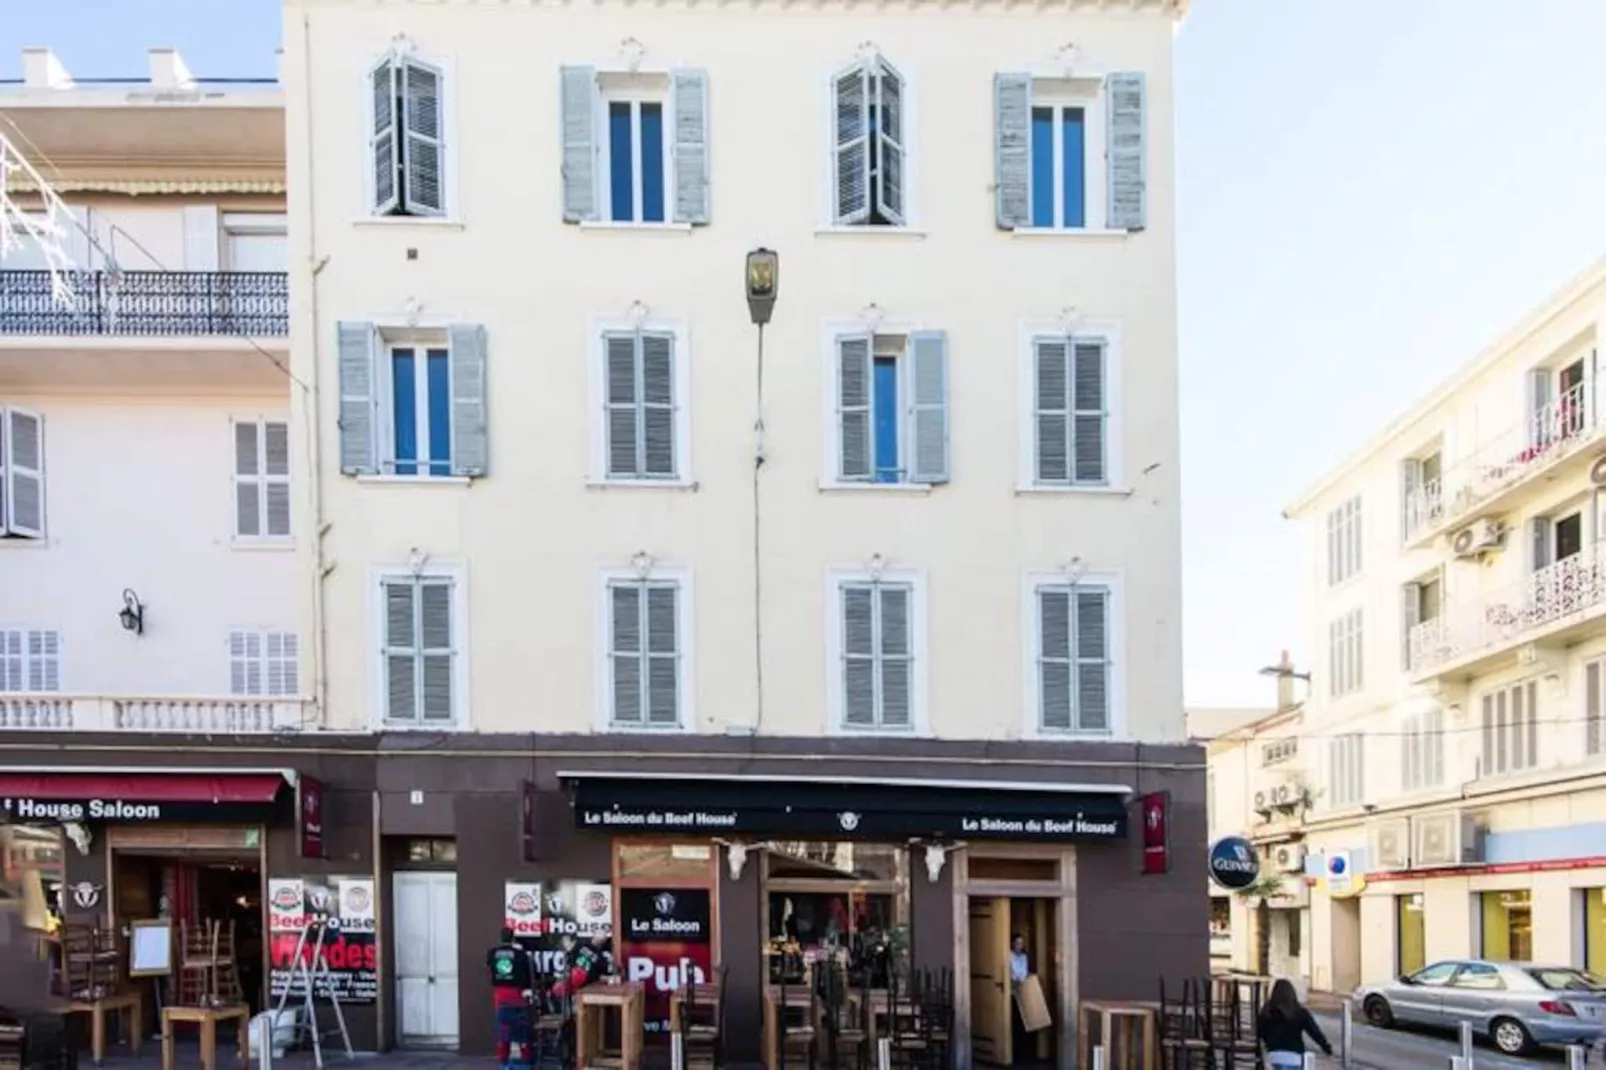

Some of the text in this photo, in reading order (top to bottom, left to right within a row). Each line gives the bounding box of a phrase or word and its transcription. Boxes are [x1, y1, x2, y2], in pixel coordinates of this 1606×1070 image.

[18, 799, 83, 817] House
[89, 799, 160, 818] Saloon
[584, 811, 736, 825] Le Saloon du Beef House
[962, 817, 1116, 834] Le Saloon du Beef House
[631, 919, 700, 932] Le Saloon
